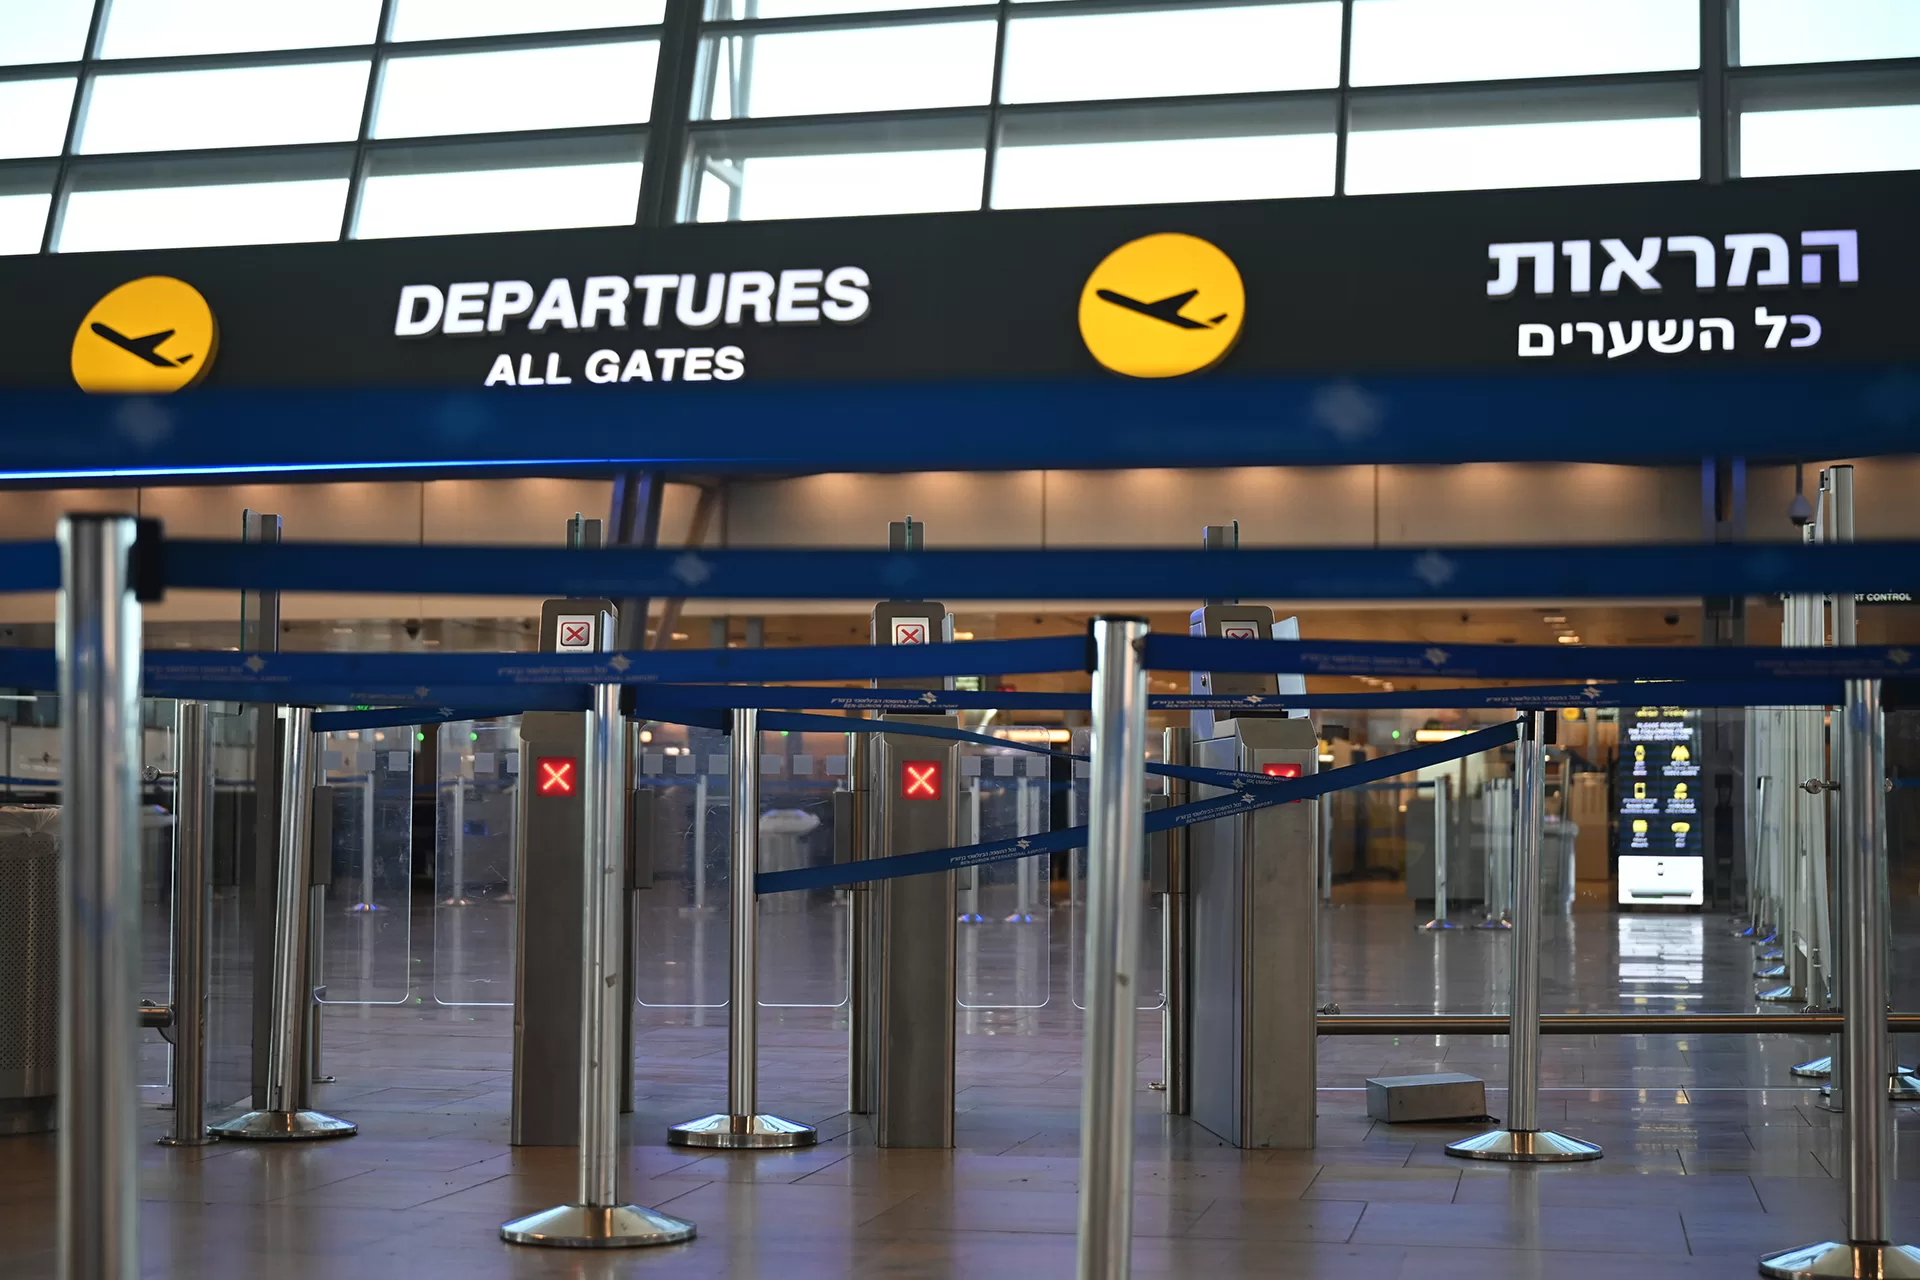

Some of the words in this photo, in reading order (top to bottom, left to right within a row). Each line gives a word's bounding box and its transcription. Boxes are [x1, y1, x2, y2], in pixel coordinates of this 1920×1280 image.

[1486, 229, 1859, 297] המראות
[394, 266, 871, 337] DEPARTURES
[1517, 317, 1735, 359] השערים
[1754, 306, 1822, 349] כל
[484, 352, 572, 387] ALL
[584, 346, 746, 384] GATES
[1866, 593, 1912, 602] CONTROL
